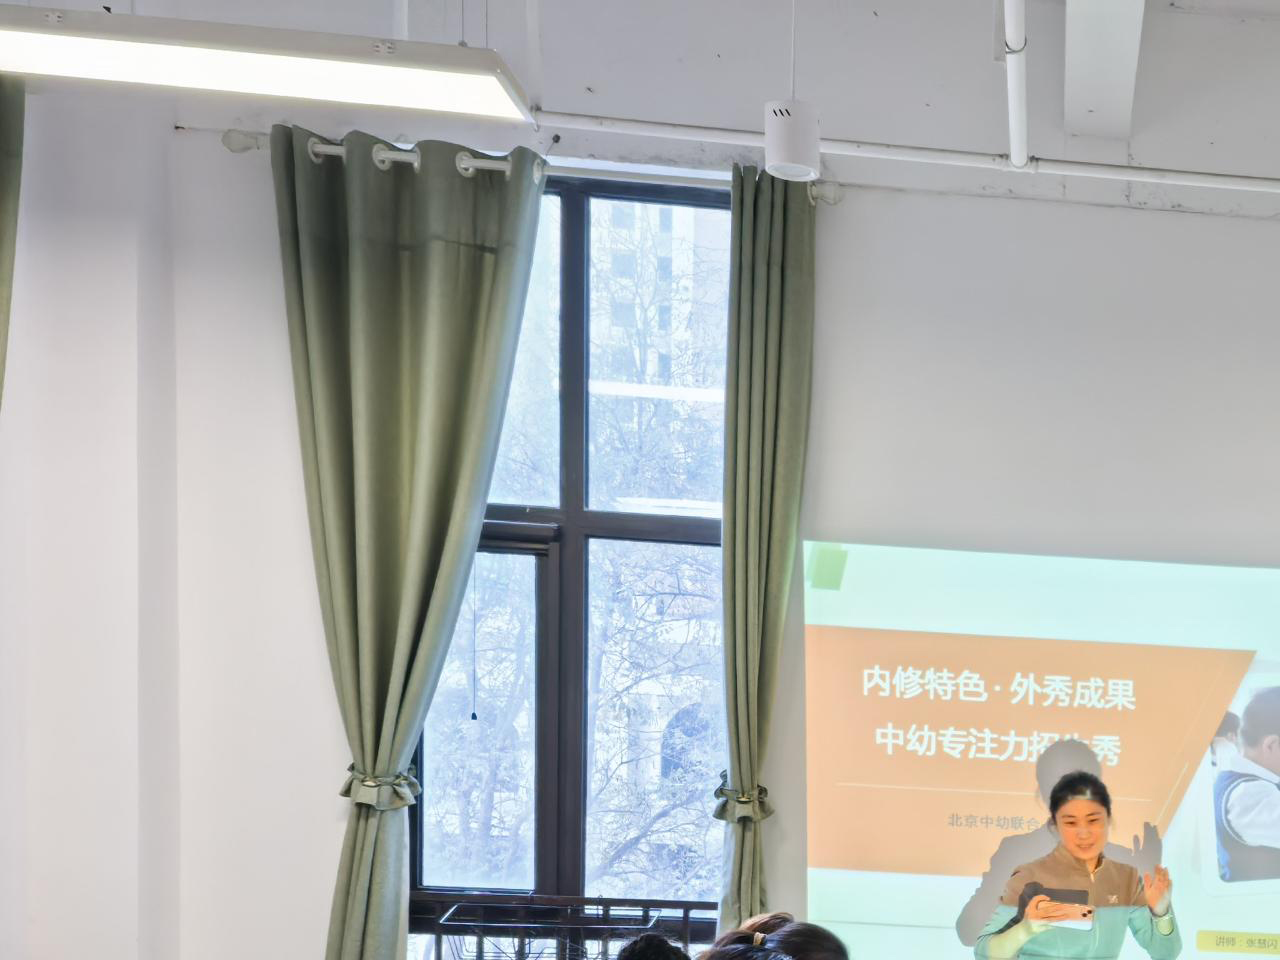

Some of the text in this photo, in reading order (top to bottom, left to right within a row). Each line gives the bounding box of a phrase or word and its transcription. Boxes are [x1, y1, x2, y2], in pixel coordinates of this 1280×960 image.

[862, 664, 1137, 710] 内修特色·外秀成果
[875, 722, 1122, 767] 中幼专注力招秀
